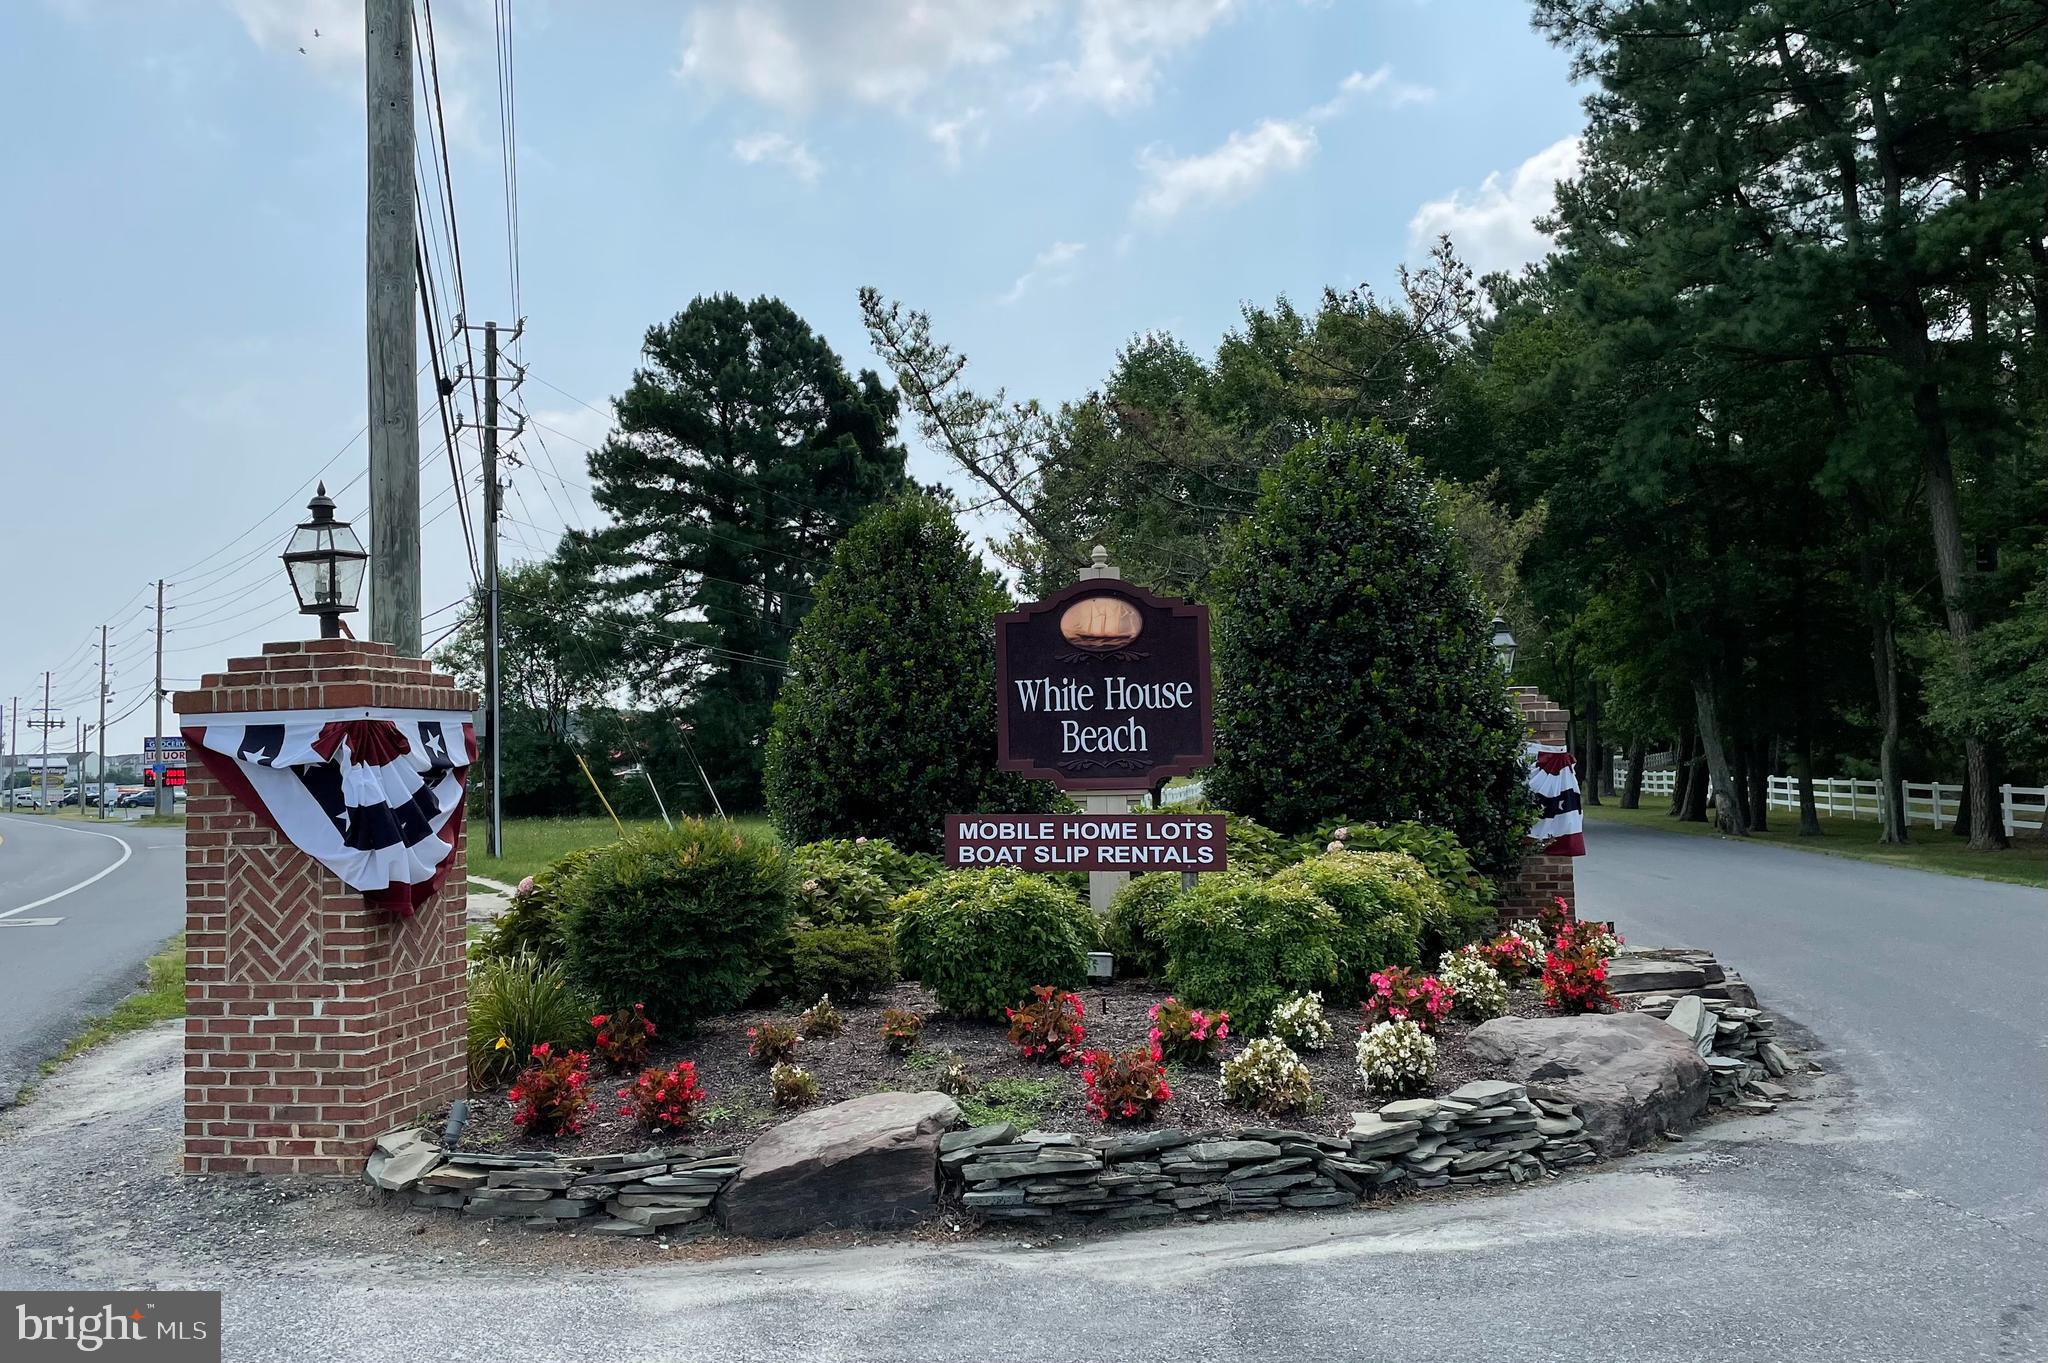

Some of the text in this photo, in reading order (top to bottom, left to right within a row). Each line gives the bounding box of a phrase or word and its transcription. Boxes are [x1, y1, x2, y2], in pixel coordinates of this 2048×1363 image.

[1014, 676, 1193, 712] White House
[1061, 716, 1148, 753] Beach
[146, 751, 185, 760] LIUOR
[959, 822, 1214, 840] MOBILE HOME LOTS
[959, 846, 1214, 863] BOAT SLIP RENTALS
